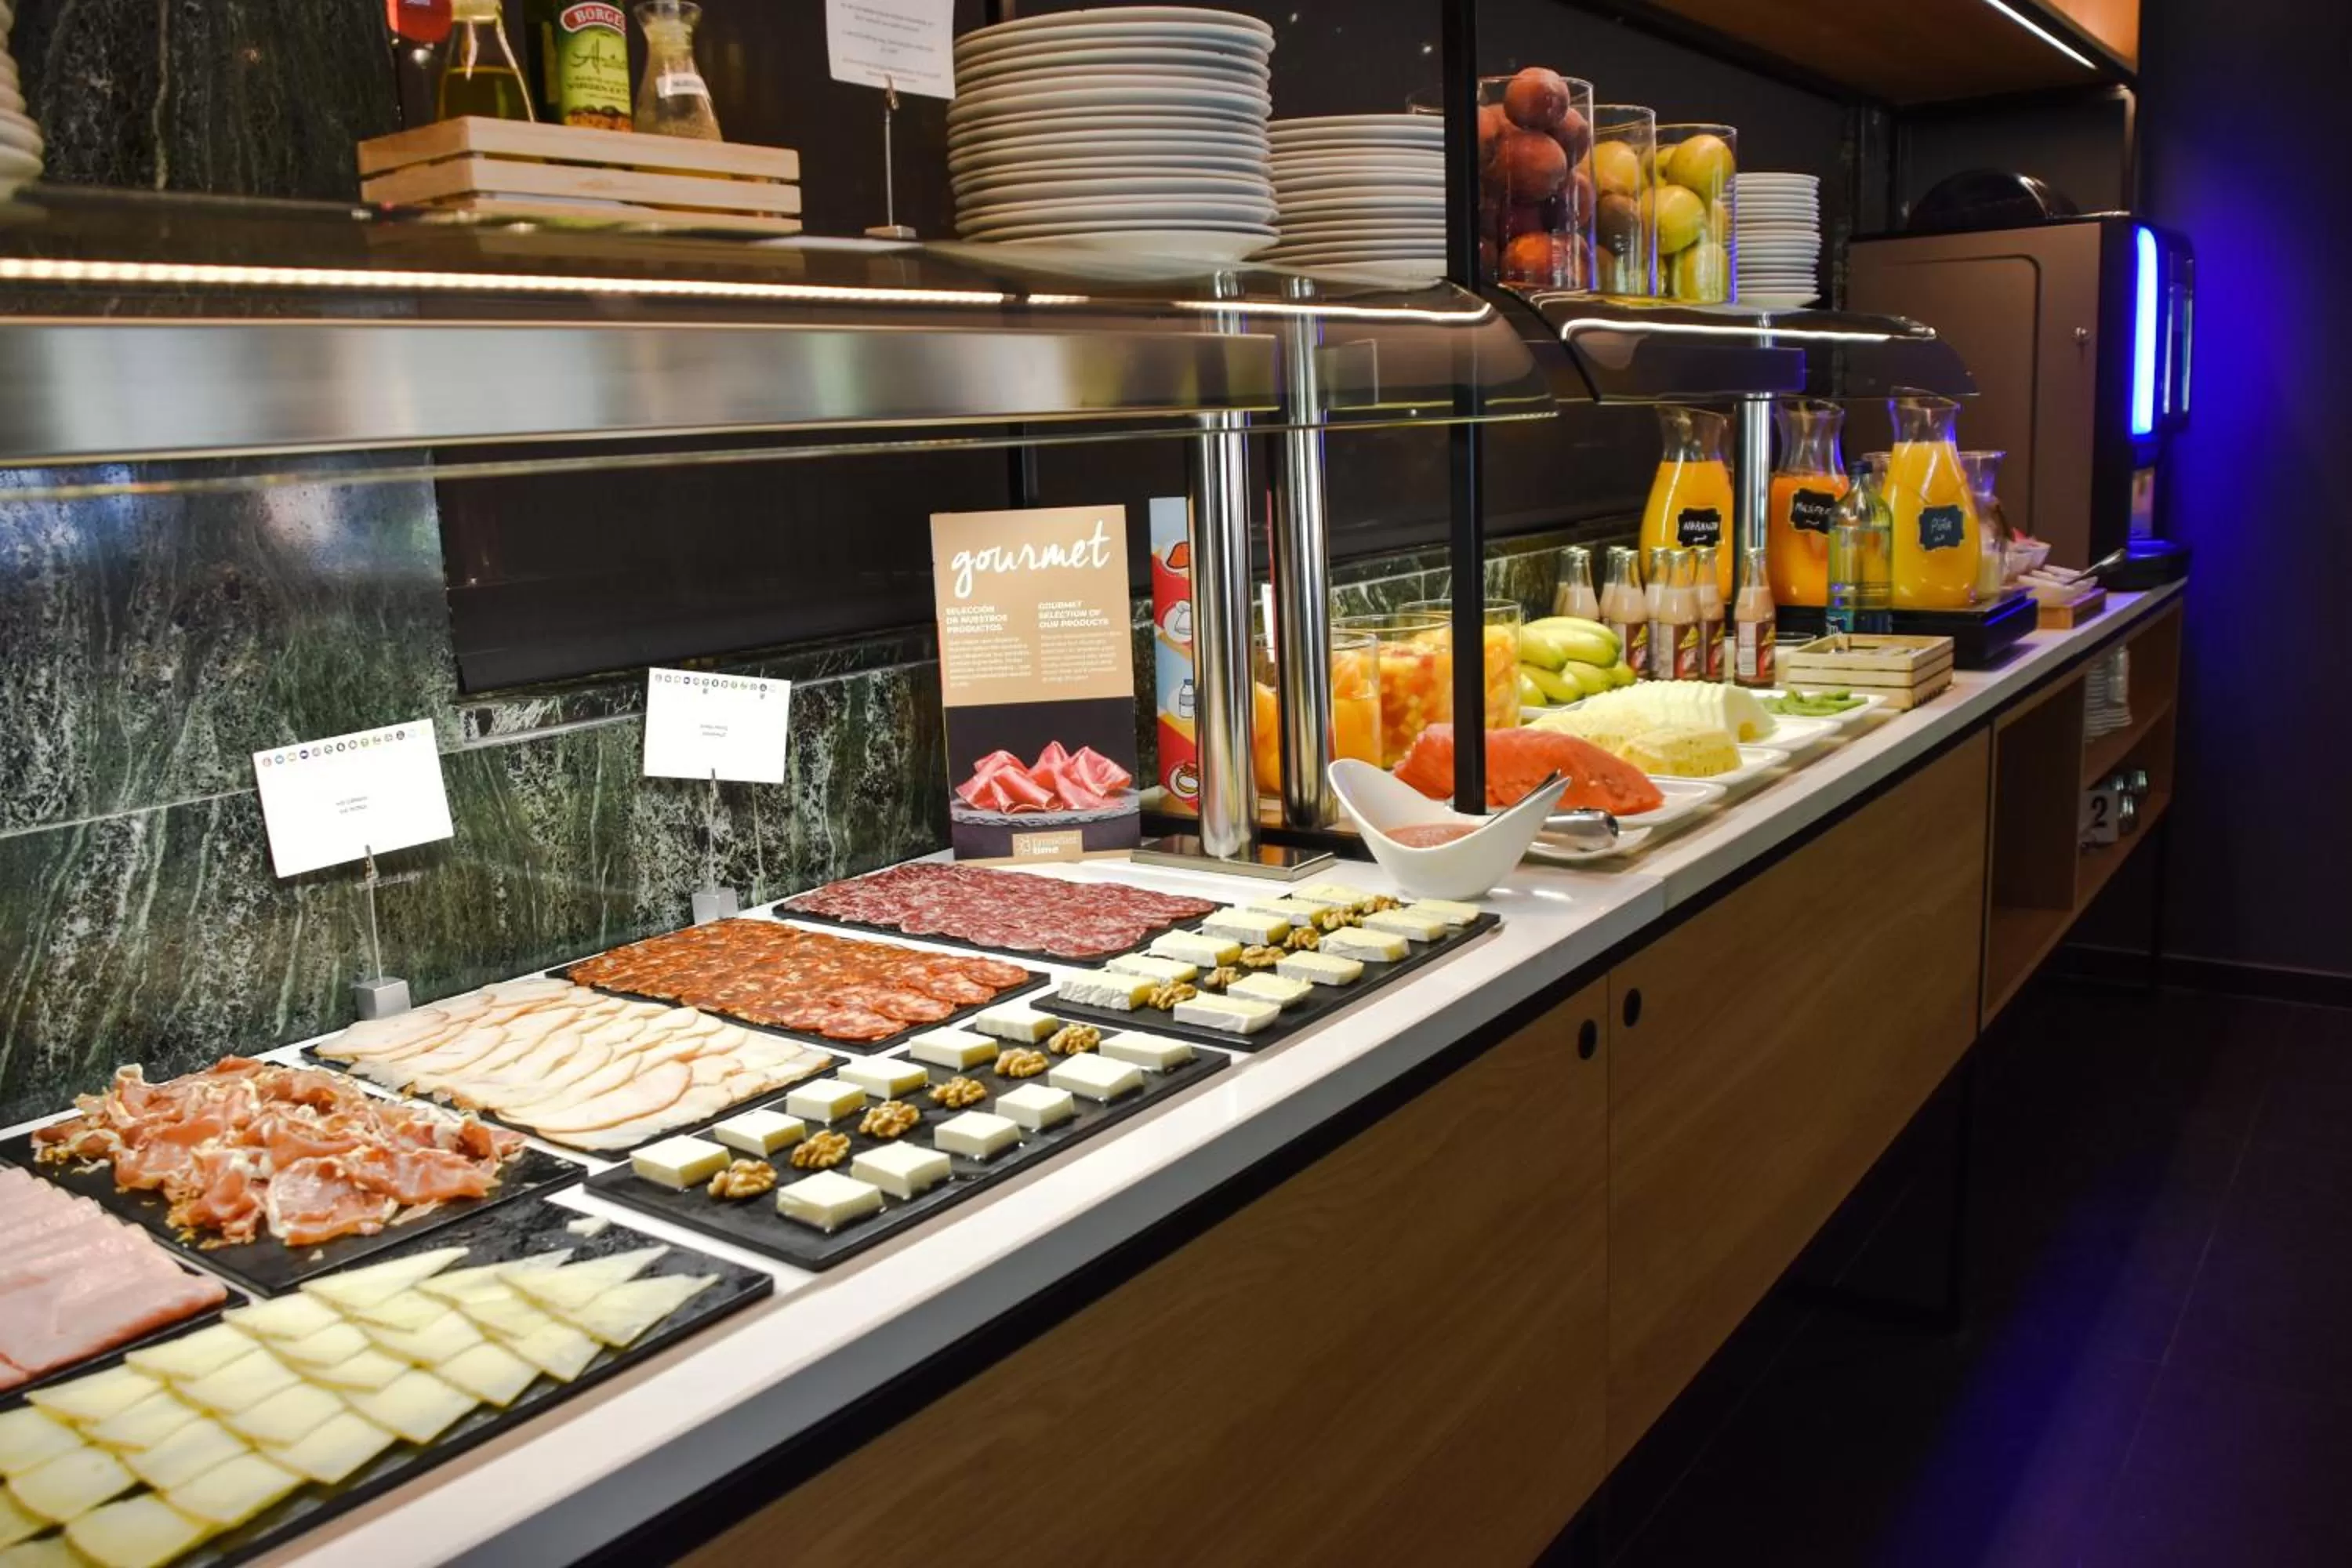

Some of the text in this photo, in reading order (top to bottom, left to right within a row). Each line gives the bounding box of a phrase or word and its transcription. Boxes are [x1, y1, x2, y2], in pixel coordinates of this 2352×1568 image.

[950, 519, 1112, 600] gourmet
[1037, 601, 1083, 610] GOURMET
[1037, 609, 1088, 619] SELECTION
[1061, 617, 1110, 628] PRODUCTS
[2090, 794, 2109, 829] 2
